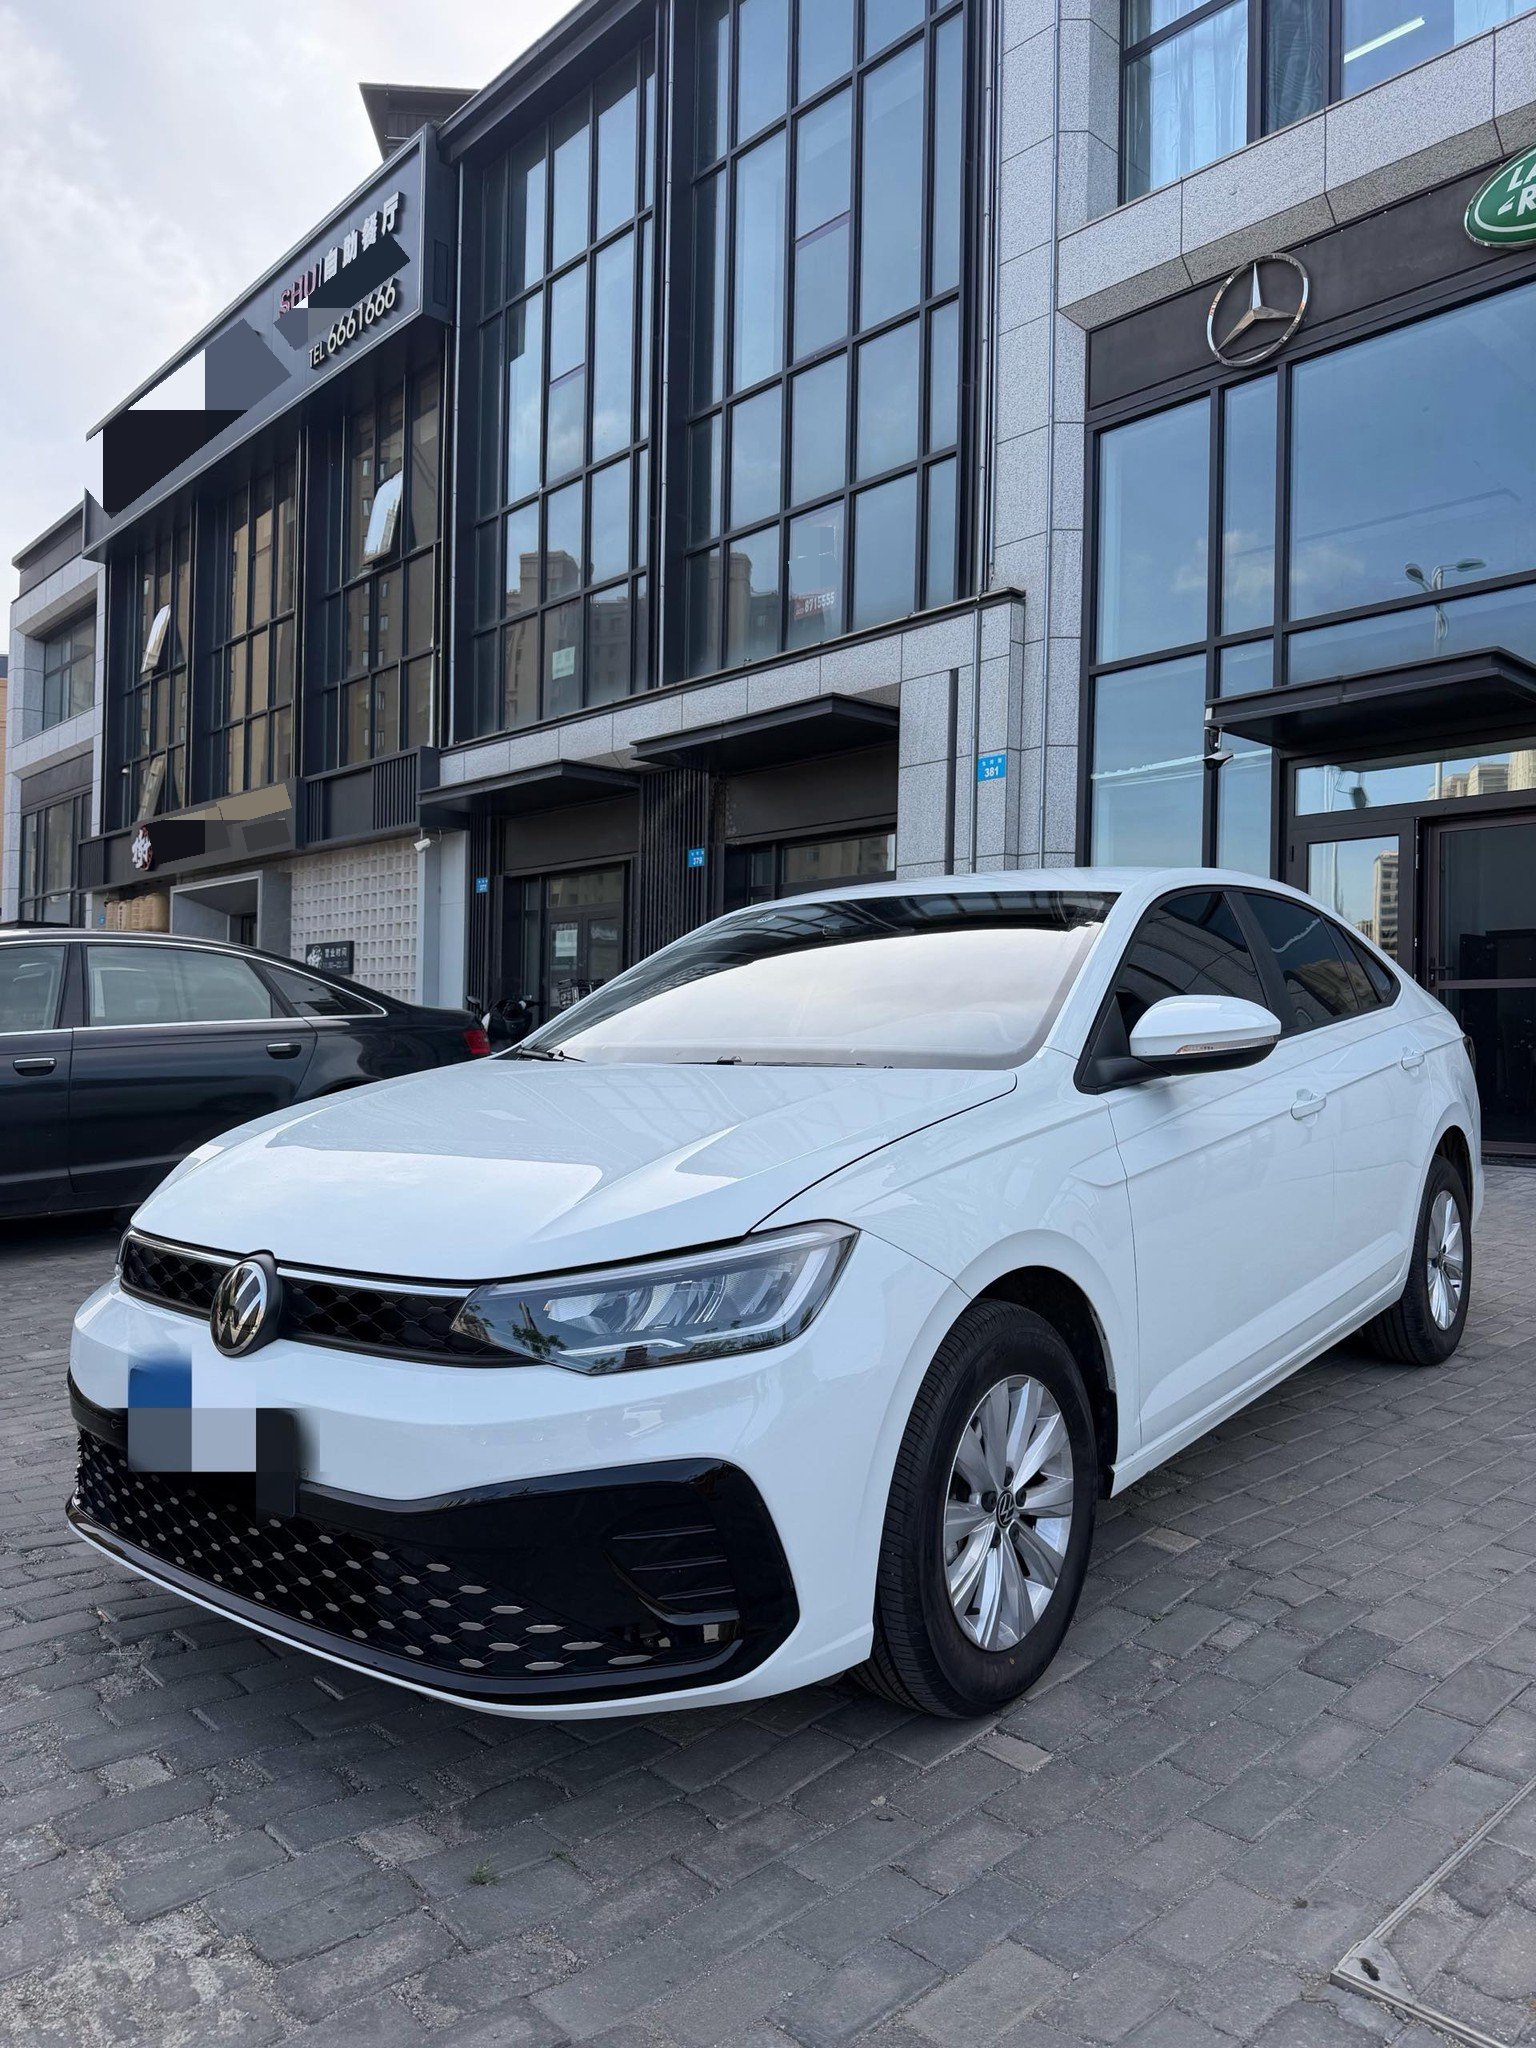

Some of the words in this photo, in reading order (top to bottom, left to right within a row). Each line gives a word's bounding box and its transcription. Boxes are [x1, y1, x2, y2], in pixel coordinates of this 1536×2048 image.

[309, 341, 325, 368] TEL
[327, 280, 396, 354] 6661666
[984, 766, 999, 778] 381
